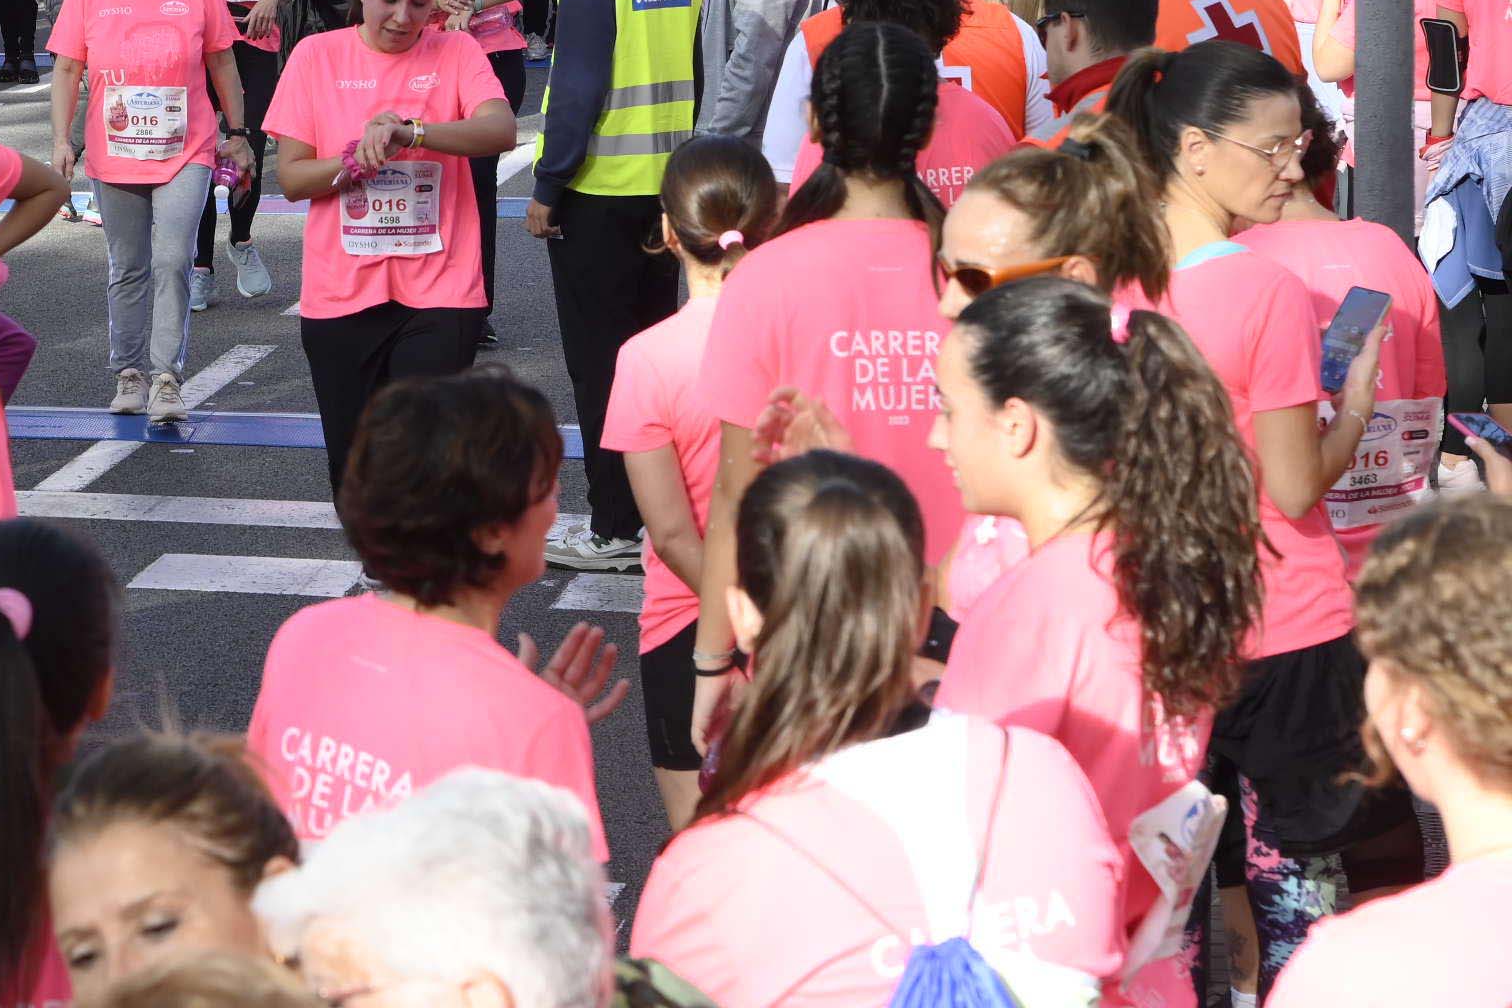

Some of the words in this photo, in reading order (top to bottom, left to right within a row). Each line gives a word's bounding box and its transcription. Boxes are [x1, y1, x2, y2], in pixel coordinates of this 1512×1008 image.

[99, 69, 126, 87] TU
[131, 115, 159, 126] 016
[371, 199, 407, 212] 016
[378, 216, 401, 225] 4598
[854, 358, 889, 384] DE
[902, 357, 937, 383] LA
[1349, 473, 1378, 487] 3463
[280, 726, 414, 799] CARRERA
[292, 767, 330, 808] DE
